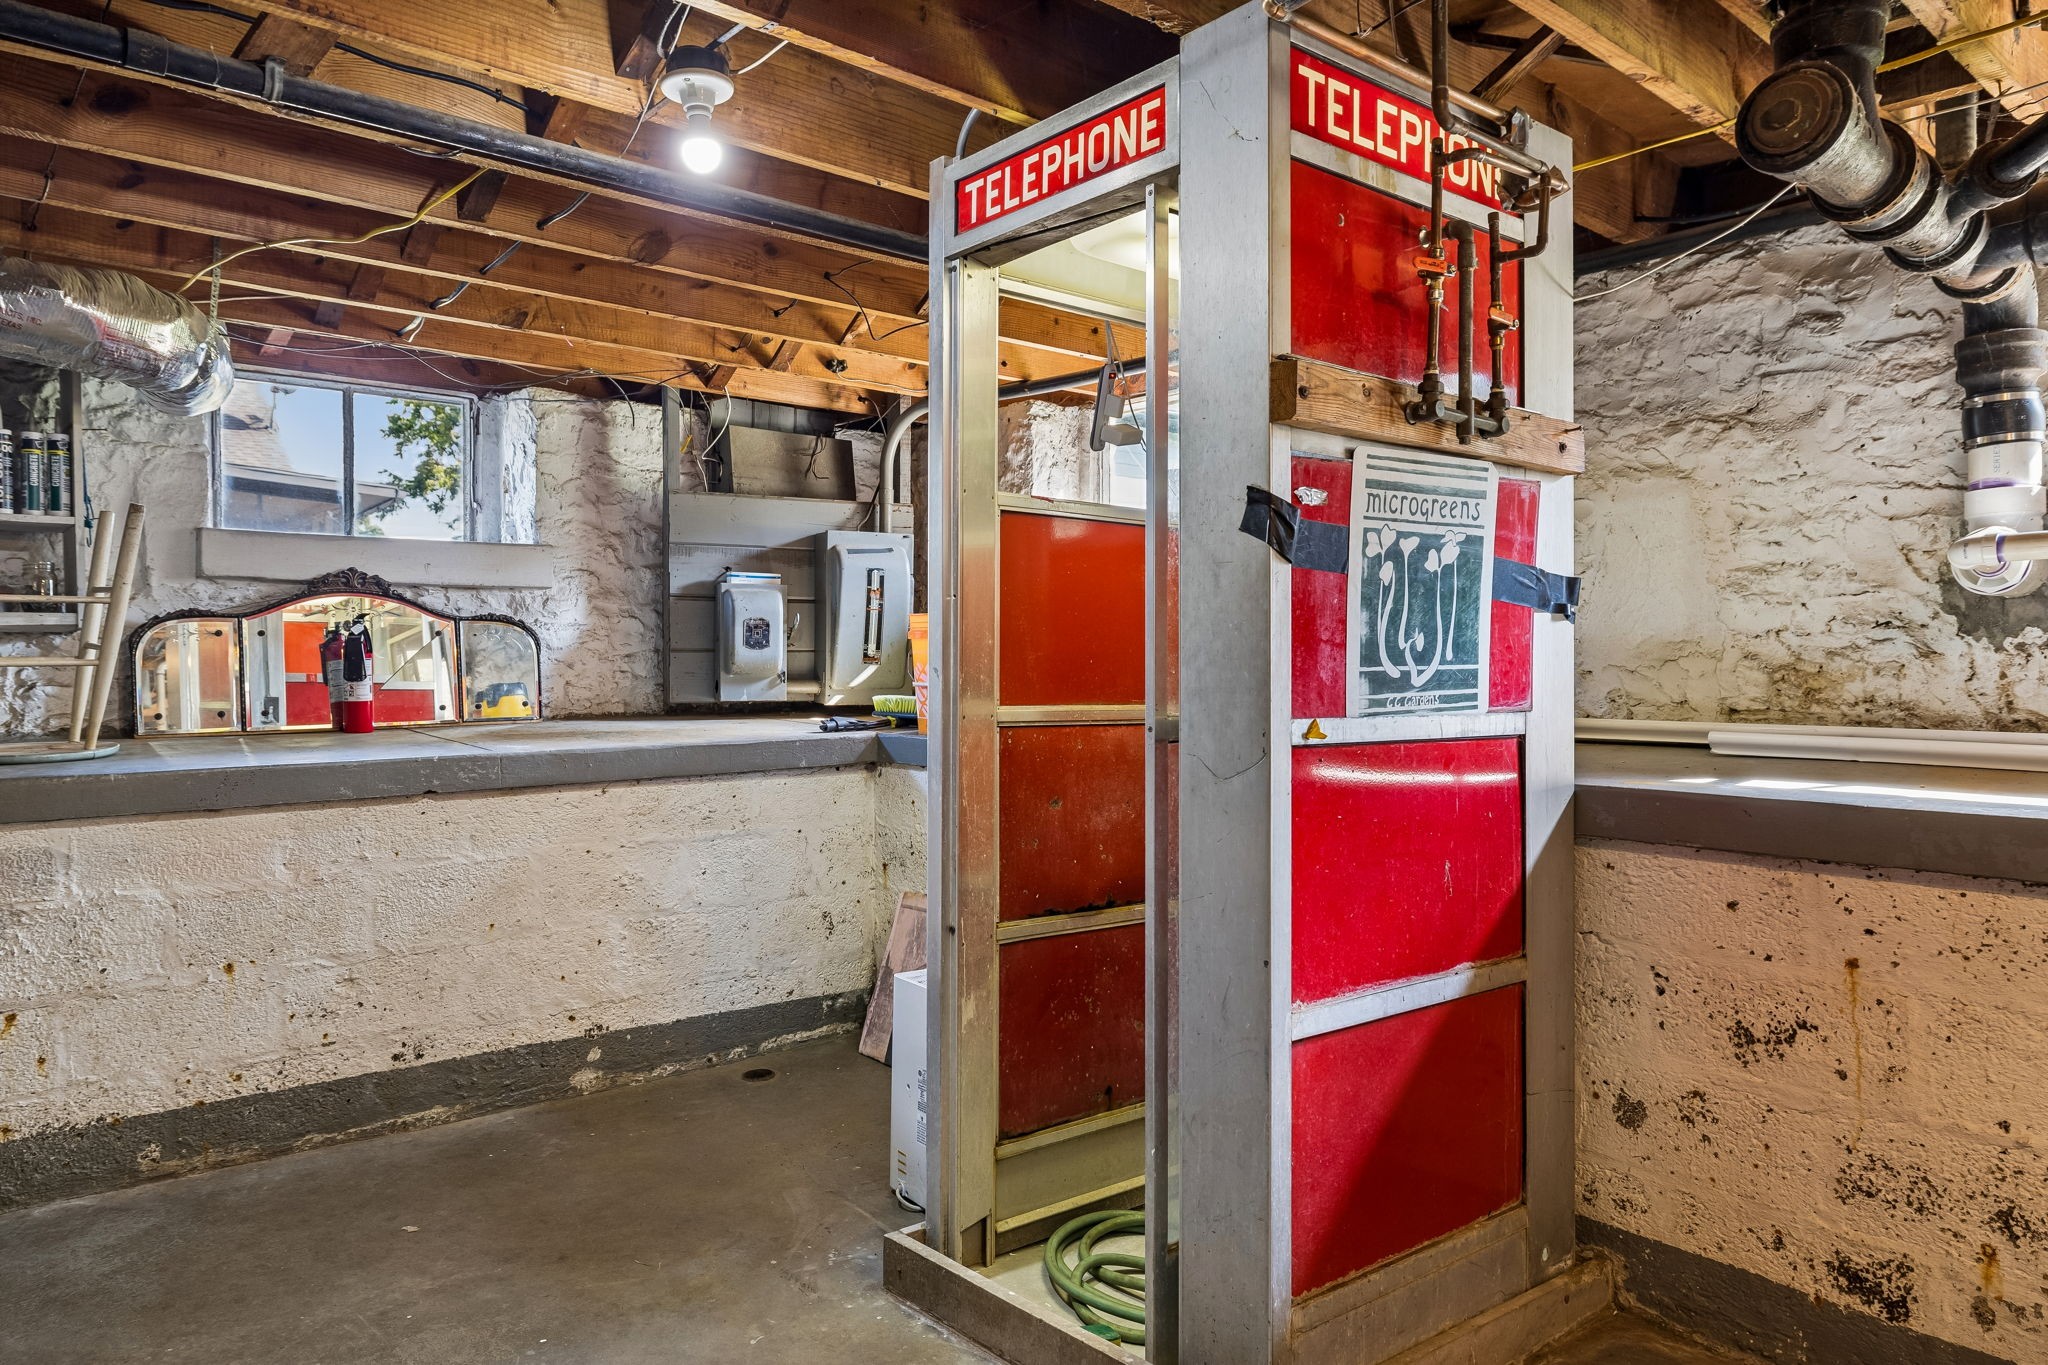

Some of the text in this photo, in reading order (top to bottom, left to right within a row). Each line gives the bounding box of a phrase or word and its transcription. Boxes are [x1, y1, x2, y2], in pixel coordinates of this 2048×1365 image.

[965, 97, 1161, 224] TELEPHONE
[29, 453, 39, 486] CONCRETE
[51, 455, 60, 487] CONCRETE
[1366, 490, 1481, 521] microgreens
